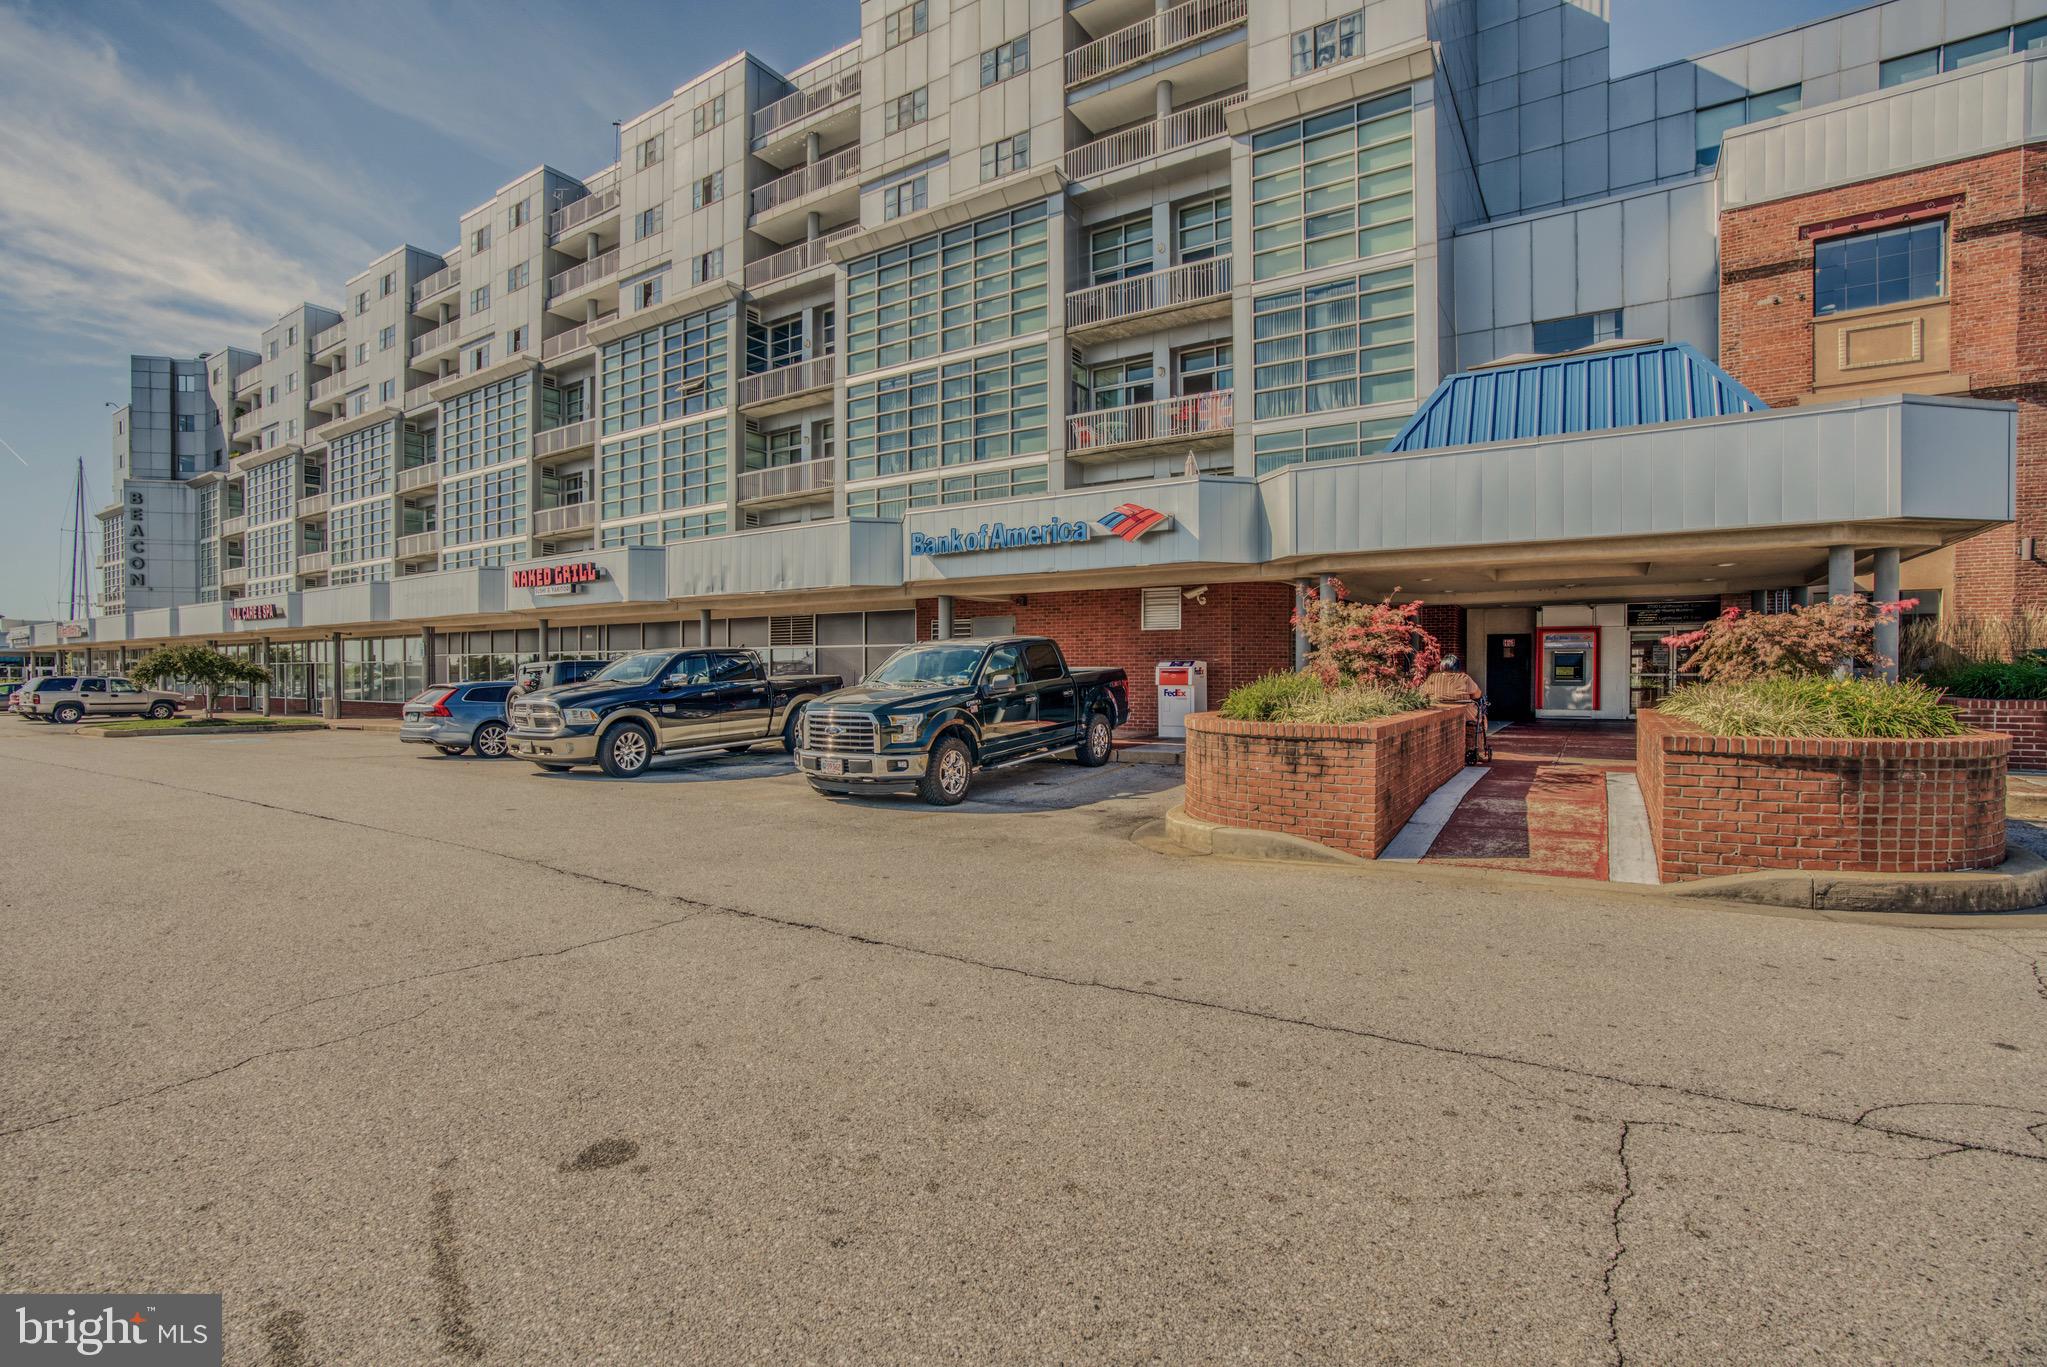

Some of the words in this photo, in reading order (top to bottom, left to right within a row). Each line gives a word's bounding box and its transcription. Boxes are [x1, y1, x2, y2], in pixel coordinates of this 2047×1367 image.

[129, 491, 145, 586] BEACON
[911, 528, 965, 555] Bank
[963, 523, 989, 550] of
[989, 517, 1088, 549] America
[513, 566, 551, 588] NAKED
[554, 562, 596, 584] GRILL
[242, 606, 257, 620] CARE
[262, 604, 274, 619] SPA
[1163, 688, 1186, 697] FedEx
